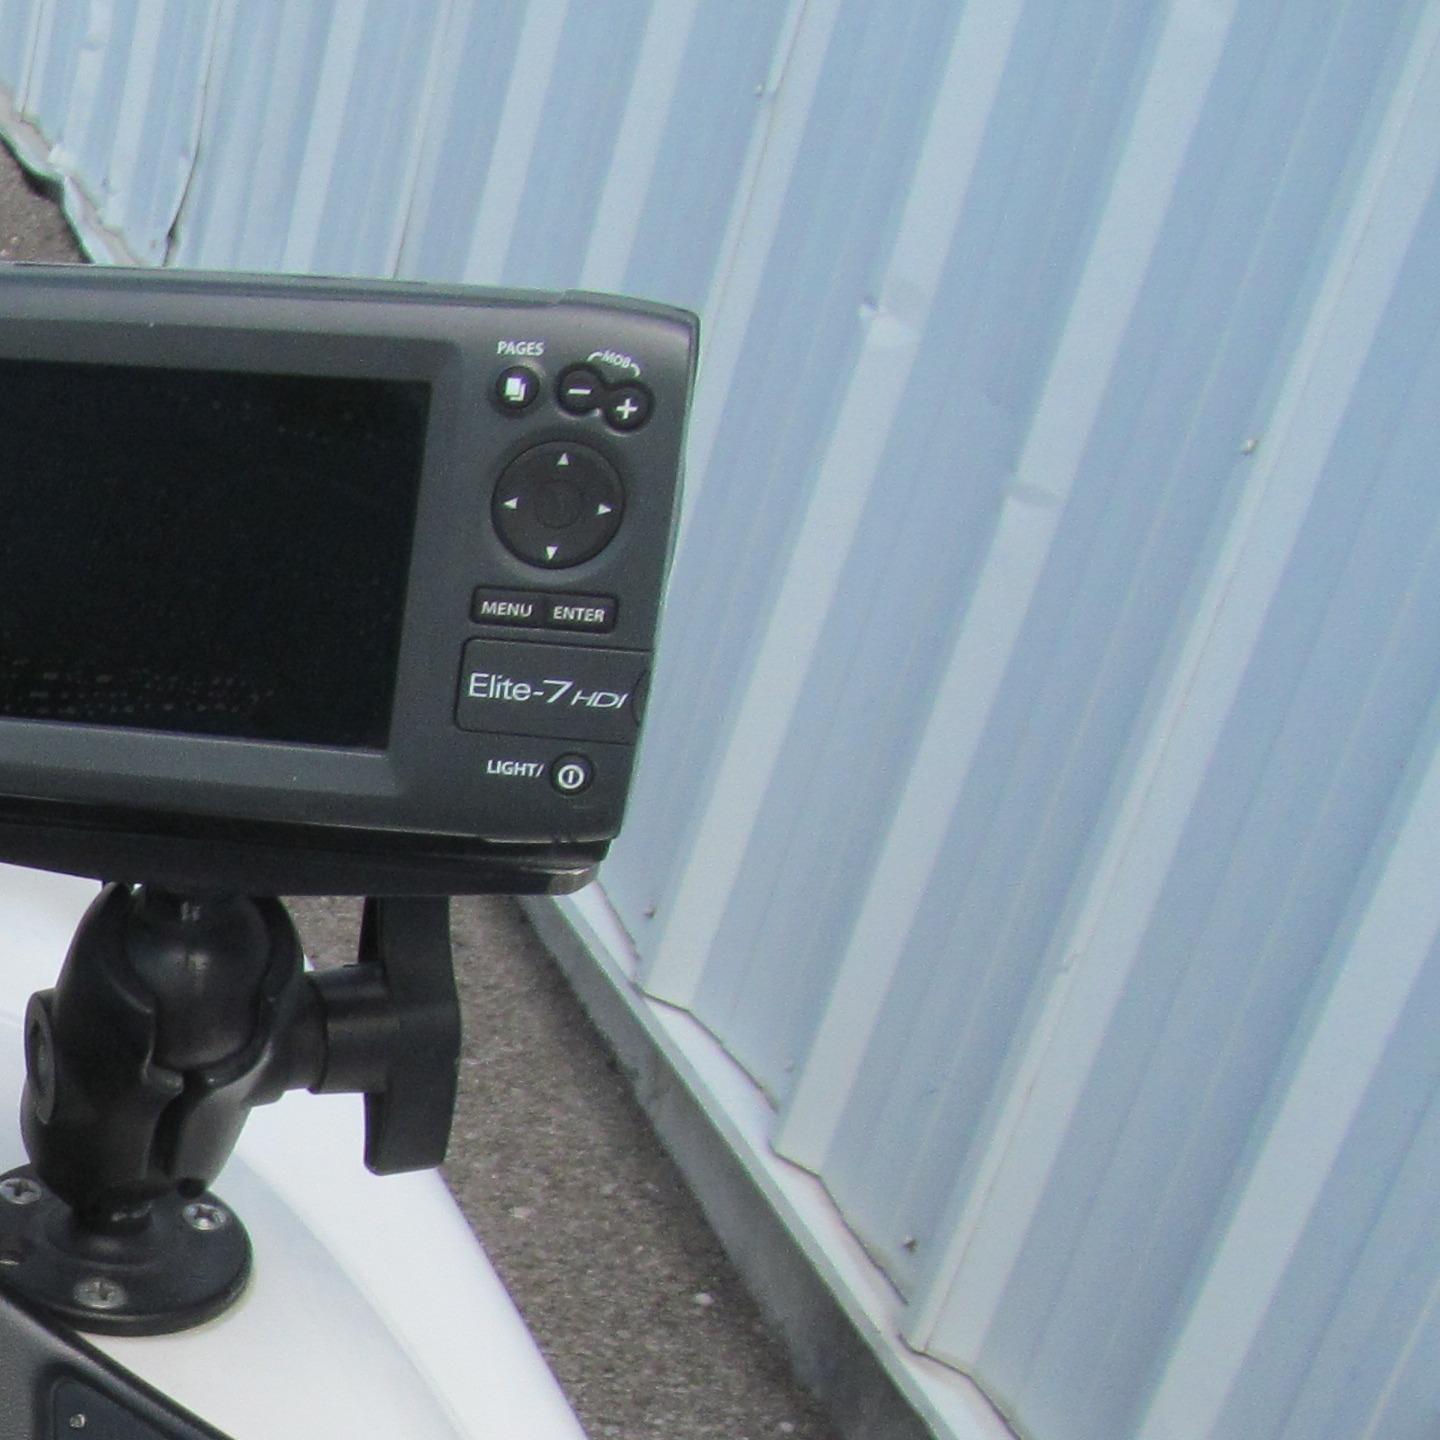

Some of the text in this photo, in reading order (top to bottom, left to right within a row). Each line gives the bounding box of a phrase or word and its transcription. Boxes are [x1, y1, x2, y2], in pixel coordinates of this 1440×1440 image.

[496, 340, 545, 356] PAGES
[602, 350, 632, 368] MOB
[481, 601, 606, 623] MENU ENTER
[468, 672, 630, 709] Elite-7 HDI
